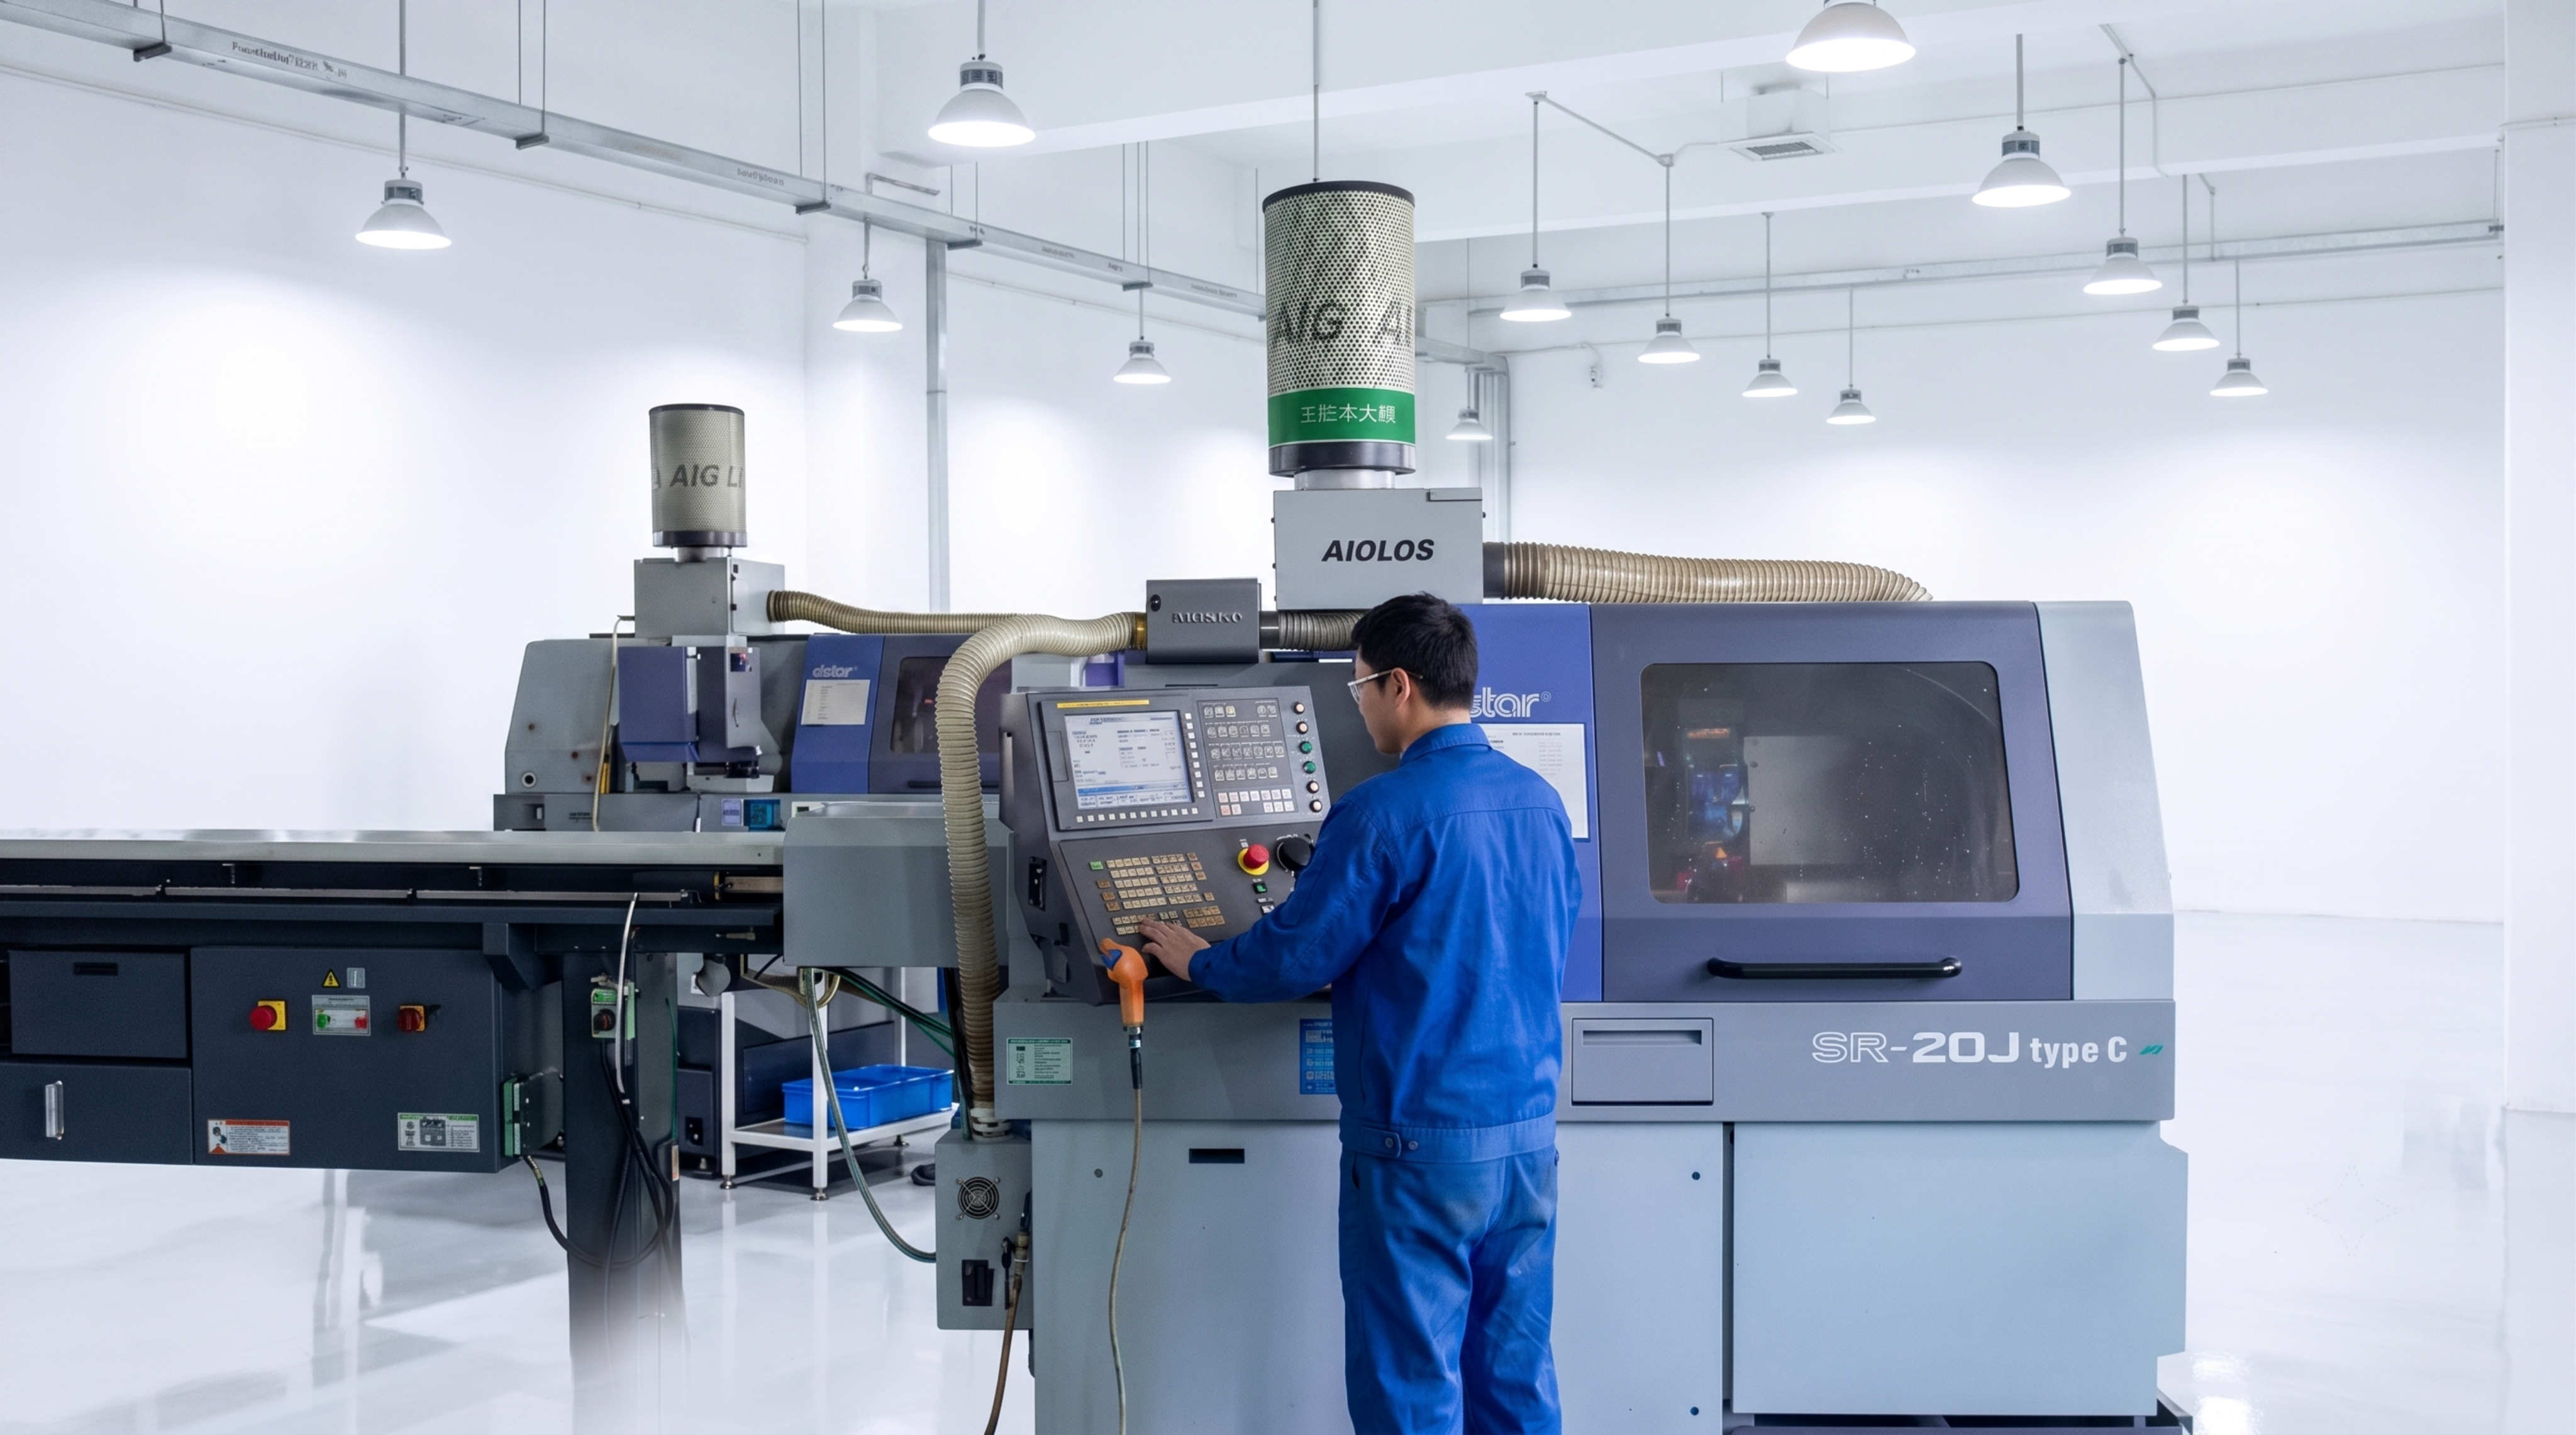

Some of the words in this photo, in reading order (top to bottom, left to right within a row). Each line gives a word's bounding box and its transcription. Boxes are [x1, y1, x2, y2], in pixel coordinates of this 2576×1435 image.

[670, 464, 719, 487] AIG
[1321, 540, 1435, 562] AIOLOS
[1812, 1032, 2019, 1063] SR-20J
[2030, 1038, 2099, 1068] type
[2107, 1036, 2128, 1063] C
